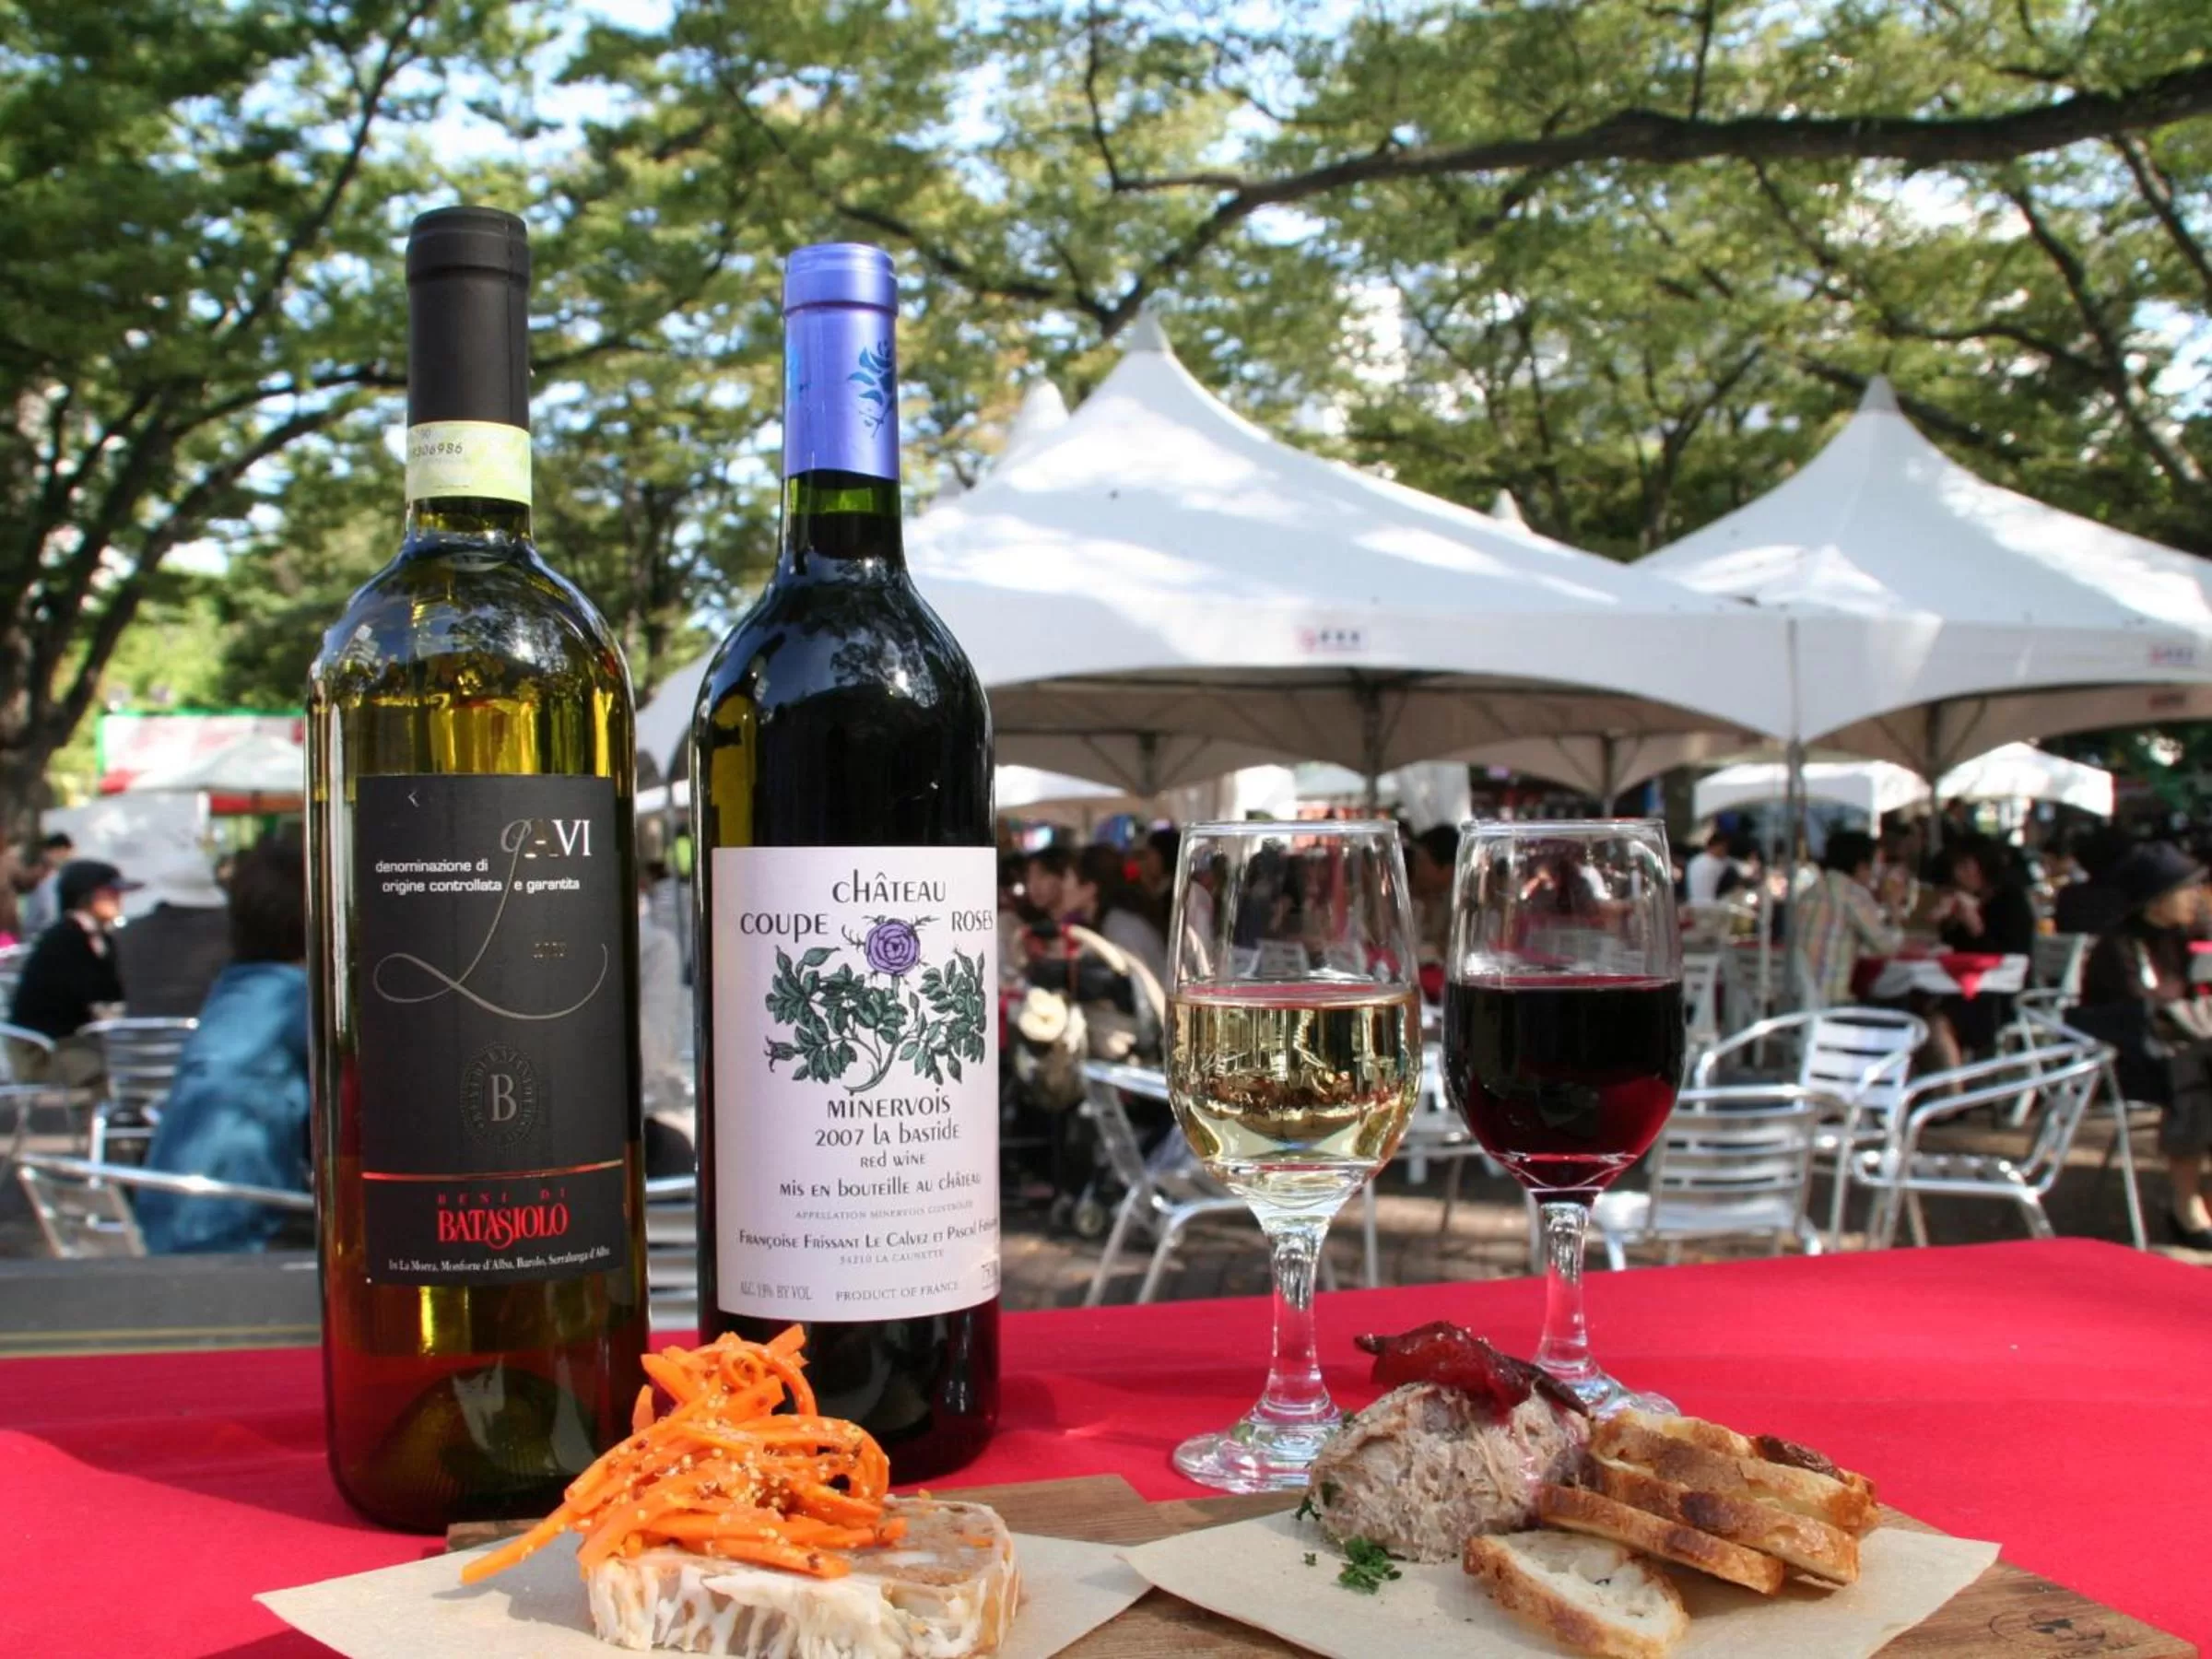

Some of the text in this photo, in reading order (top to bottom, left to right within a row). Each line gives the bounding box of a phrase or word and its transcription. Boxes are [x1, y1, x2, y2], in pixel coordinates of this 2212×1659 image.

[375, 858, 488, 872] denominazione di
[382, 877, 581, 896] origine controllata e garantita
[740, 912, 830, 943] COUPE
[827, 1088, 951, 1119] MINERVOIS
[815, 1128, 865, 1147] 2007
[892, 1150, 926, 1167] WINE
[811, 1185, 830, 1196] EN
[916, 1179, 933, 1193] AU
[438, 1202, 570, 1250] BATASIOLO
[836, 1288, 896, 1301] PRODUCT
[900, 1287, 918, 1297] OF
